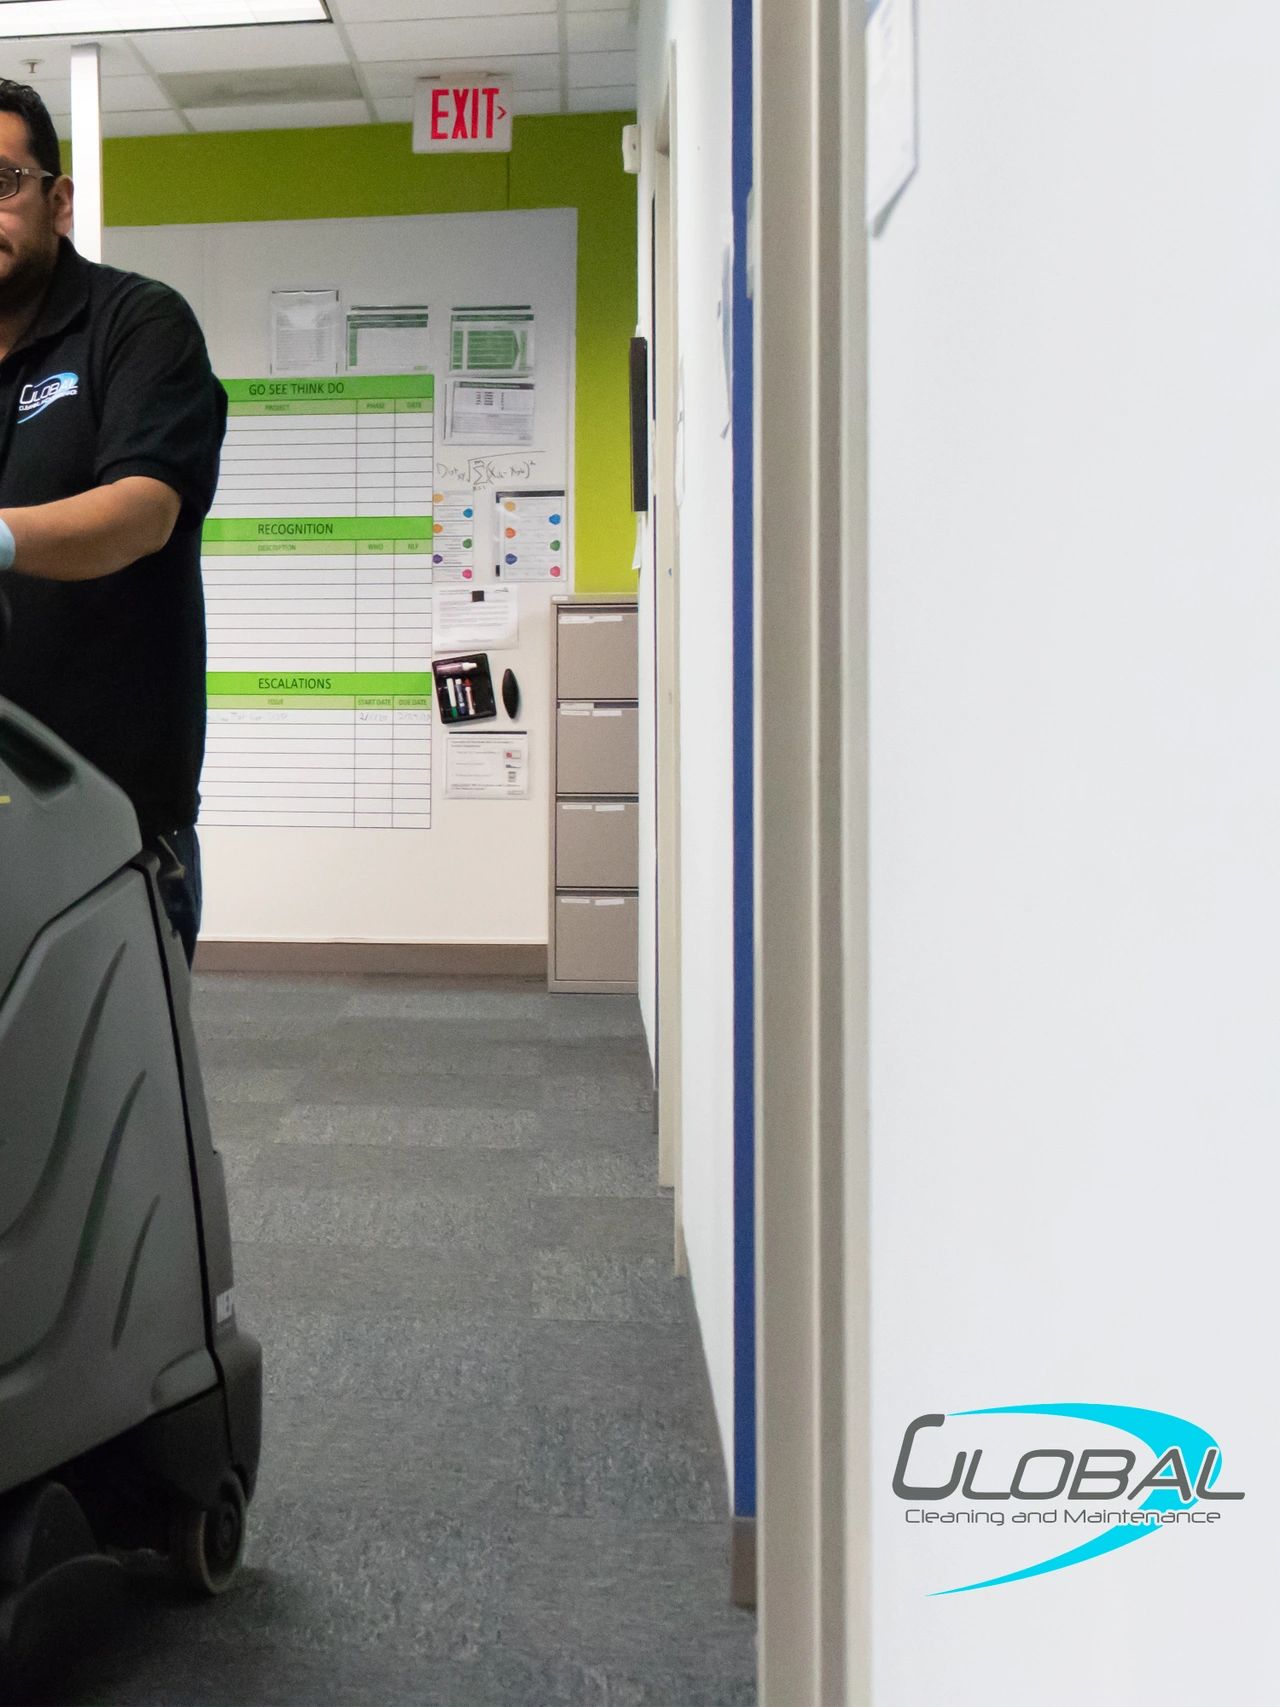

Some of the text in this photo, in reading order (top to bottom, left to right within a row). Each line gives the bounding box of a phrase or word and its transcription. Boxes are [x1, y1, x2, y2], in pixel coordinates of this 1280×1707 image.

[430, 87, 499, 139] EXIT
[249, 382, 344, 396] GO SEE THINK DO
[258, 523, 333, 535] RECOGNITION
[258, 678, 331, 690] ESCALATIONS
